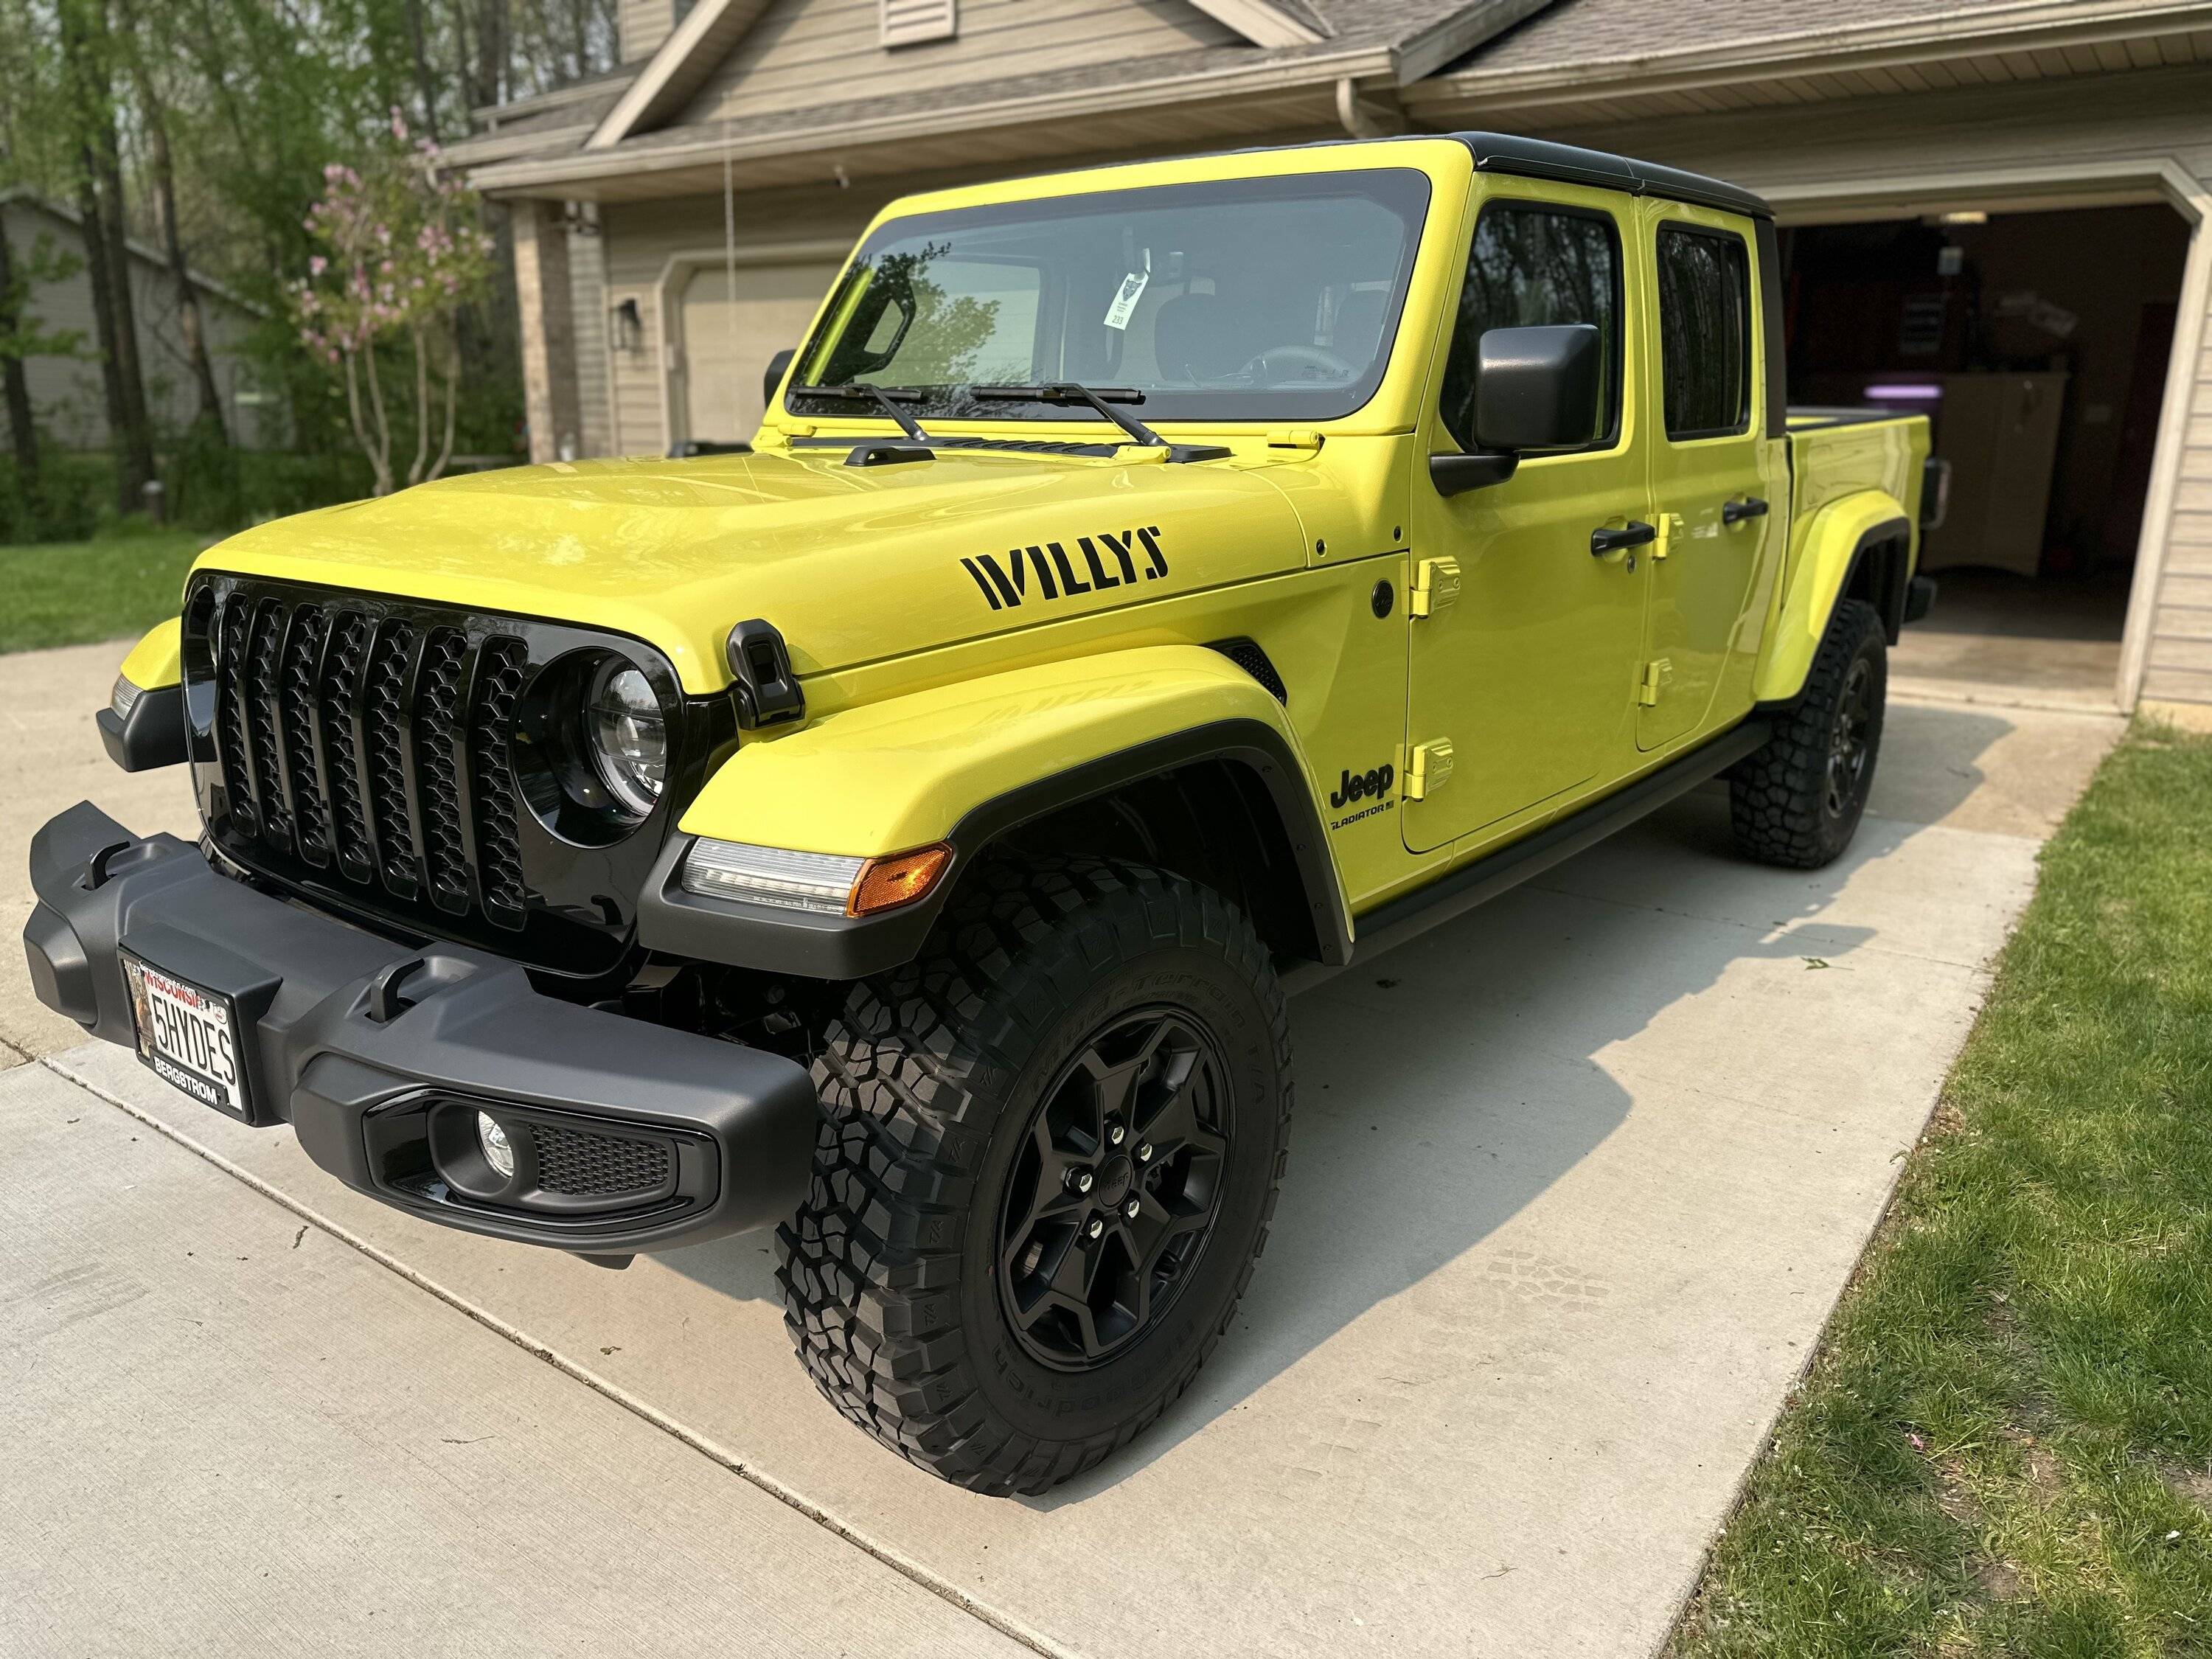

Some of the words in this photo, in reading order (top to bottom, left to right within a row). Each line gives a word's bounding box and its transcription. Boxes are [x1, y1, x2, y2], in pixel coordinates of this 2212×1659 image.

[959, 526, 1169, 611] WILLYS
[1330, 764, 1394, 808] Jeep
[151, 993, 236, 1086] 5HYDES
[153, 1056, 218, 1105] BERGSTROM
